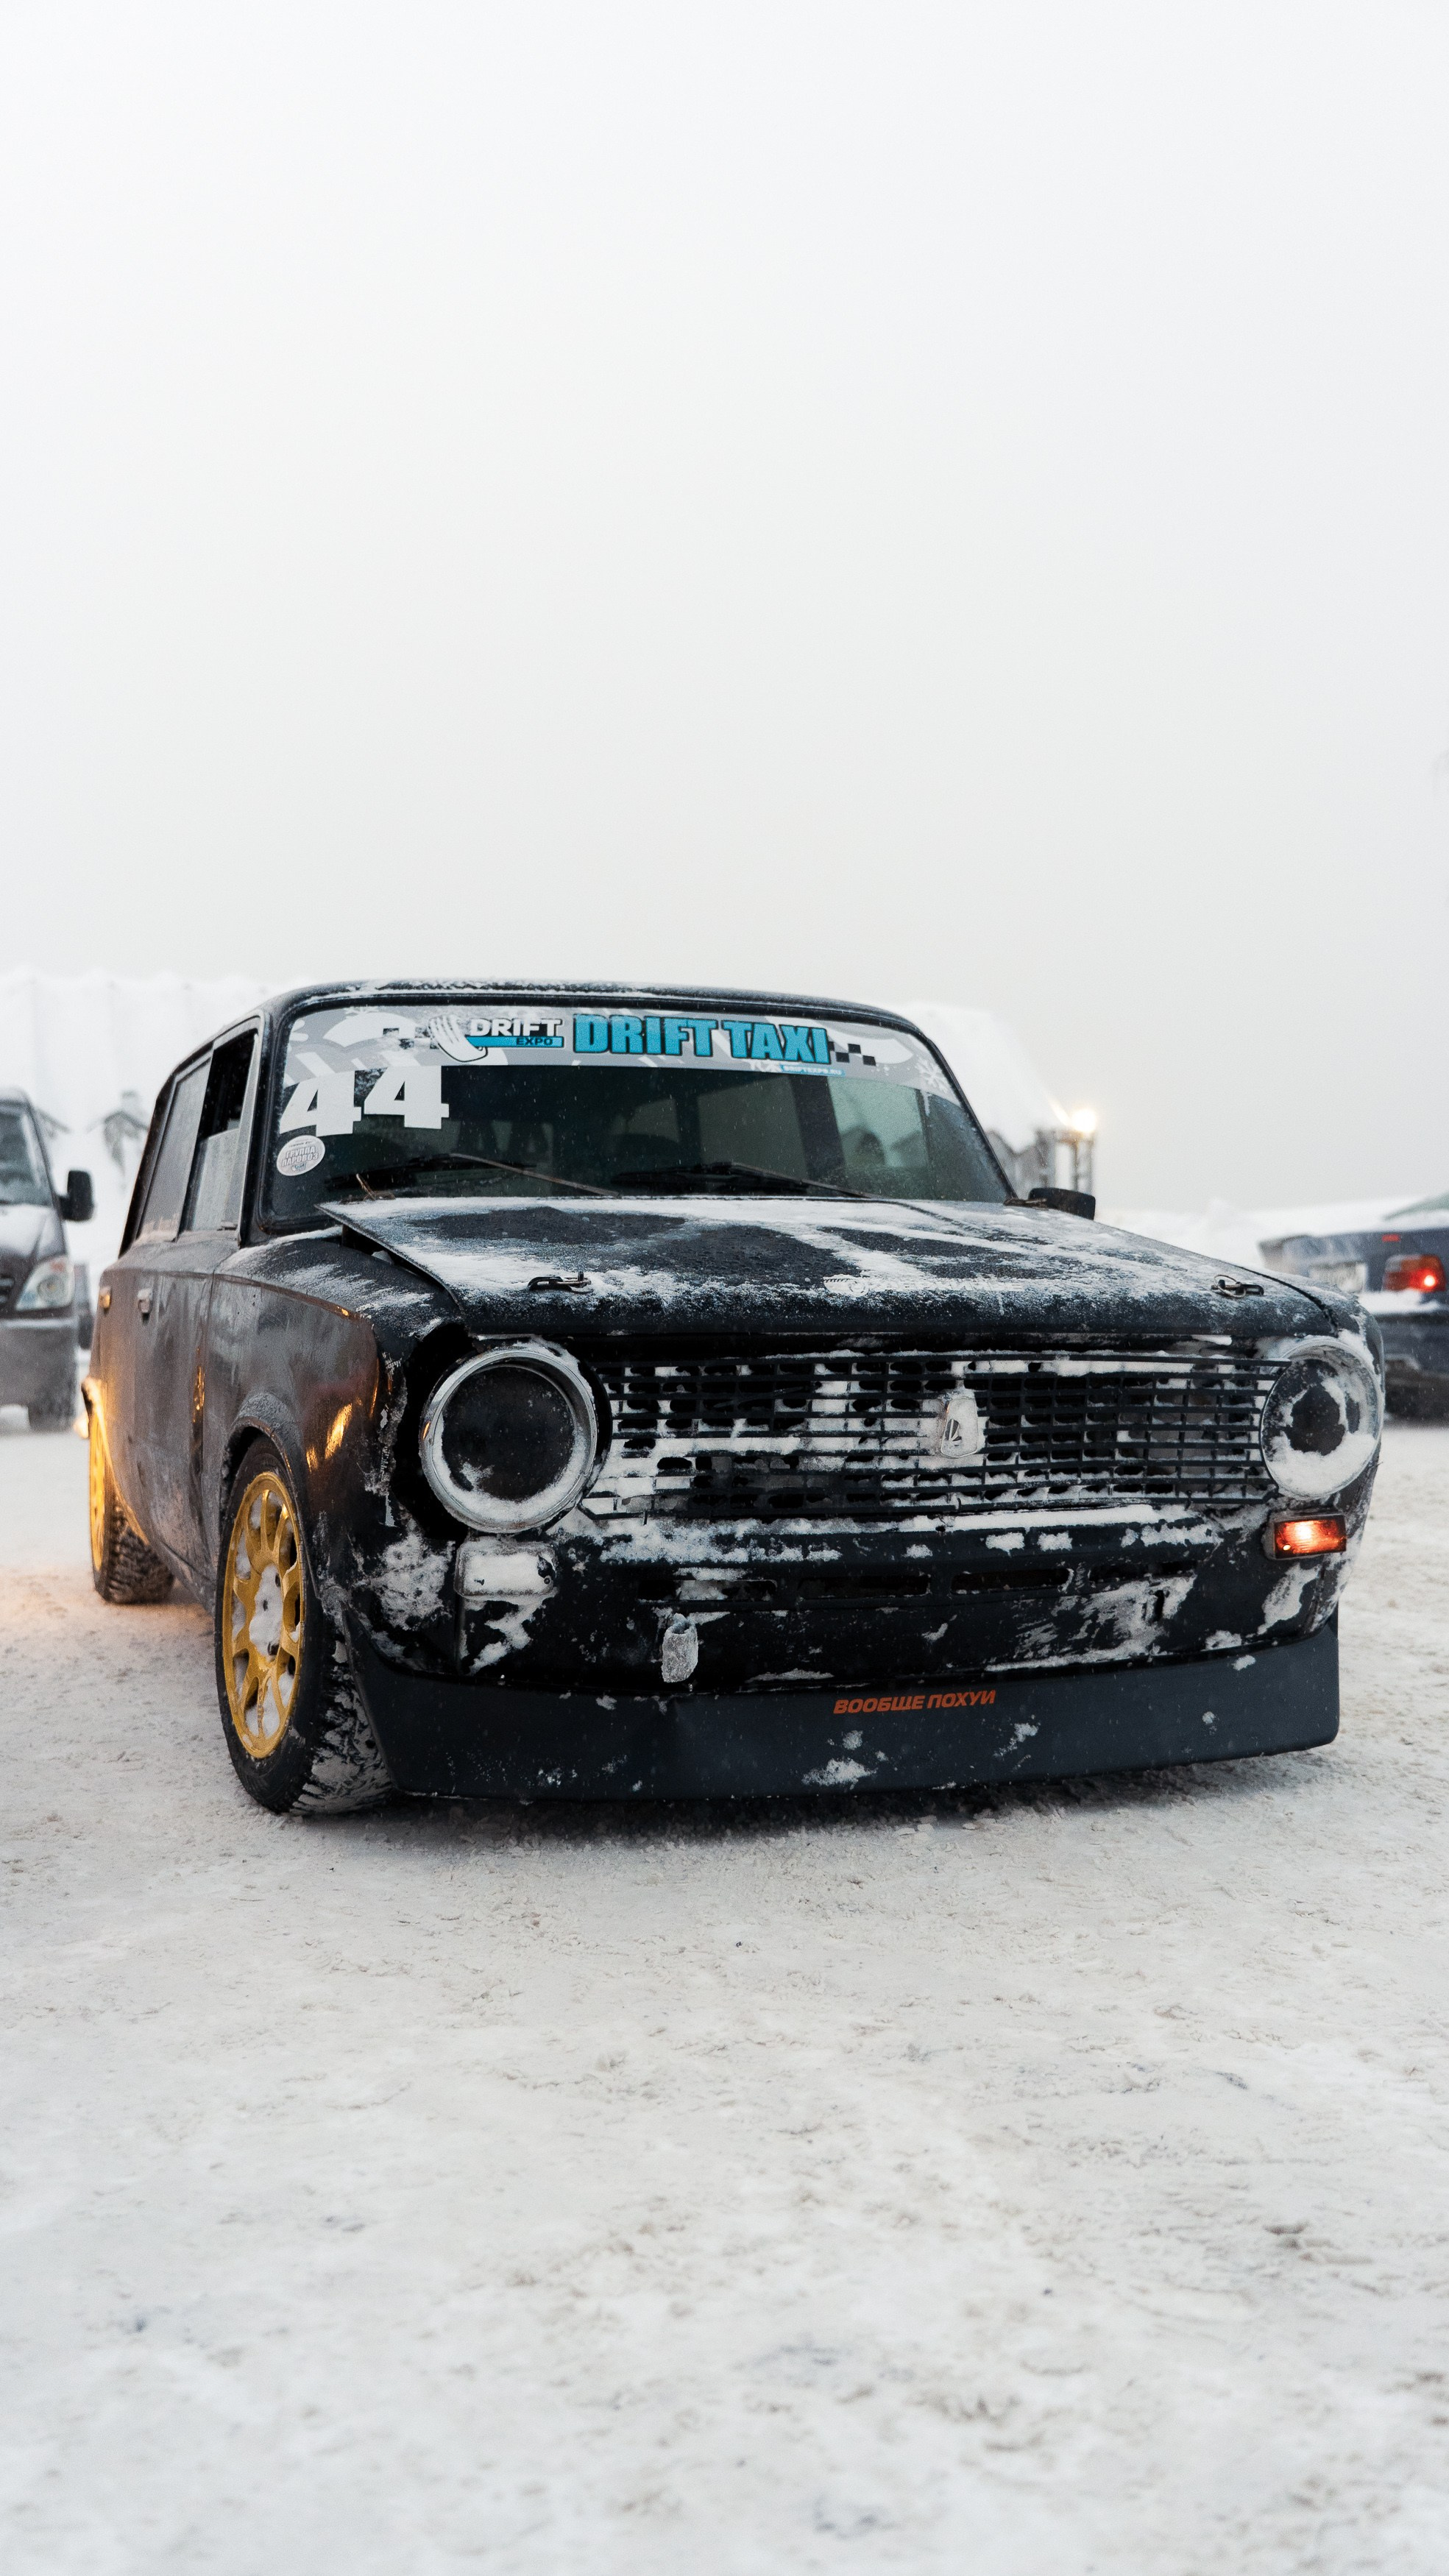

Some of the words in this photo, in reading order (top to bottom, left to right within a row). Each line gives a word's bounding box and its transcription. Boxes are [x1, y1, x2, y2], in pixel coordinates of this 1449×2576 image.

[470, 1017, 563, 1038] DRIFT
[515, 1036, 553, 1046] EXPO
[573, 1013, 718, 1057] DRIFT
[720, 1019, 832, 1064] TAXI
[279, 1064, 450, 1137] 44
[280, 1153, 319, 1167] ПАРОВОЗ
[286, 1145, 316, 1159] ГРУППА
